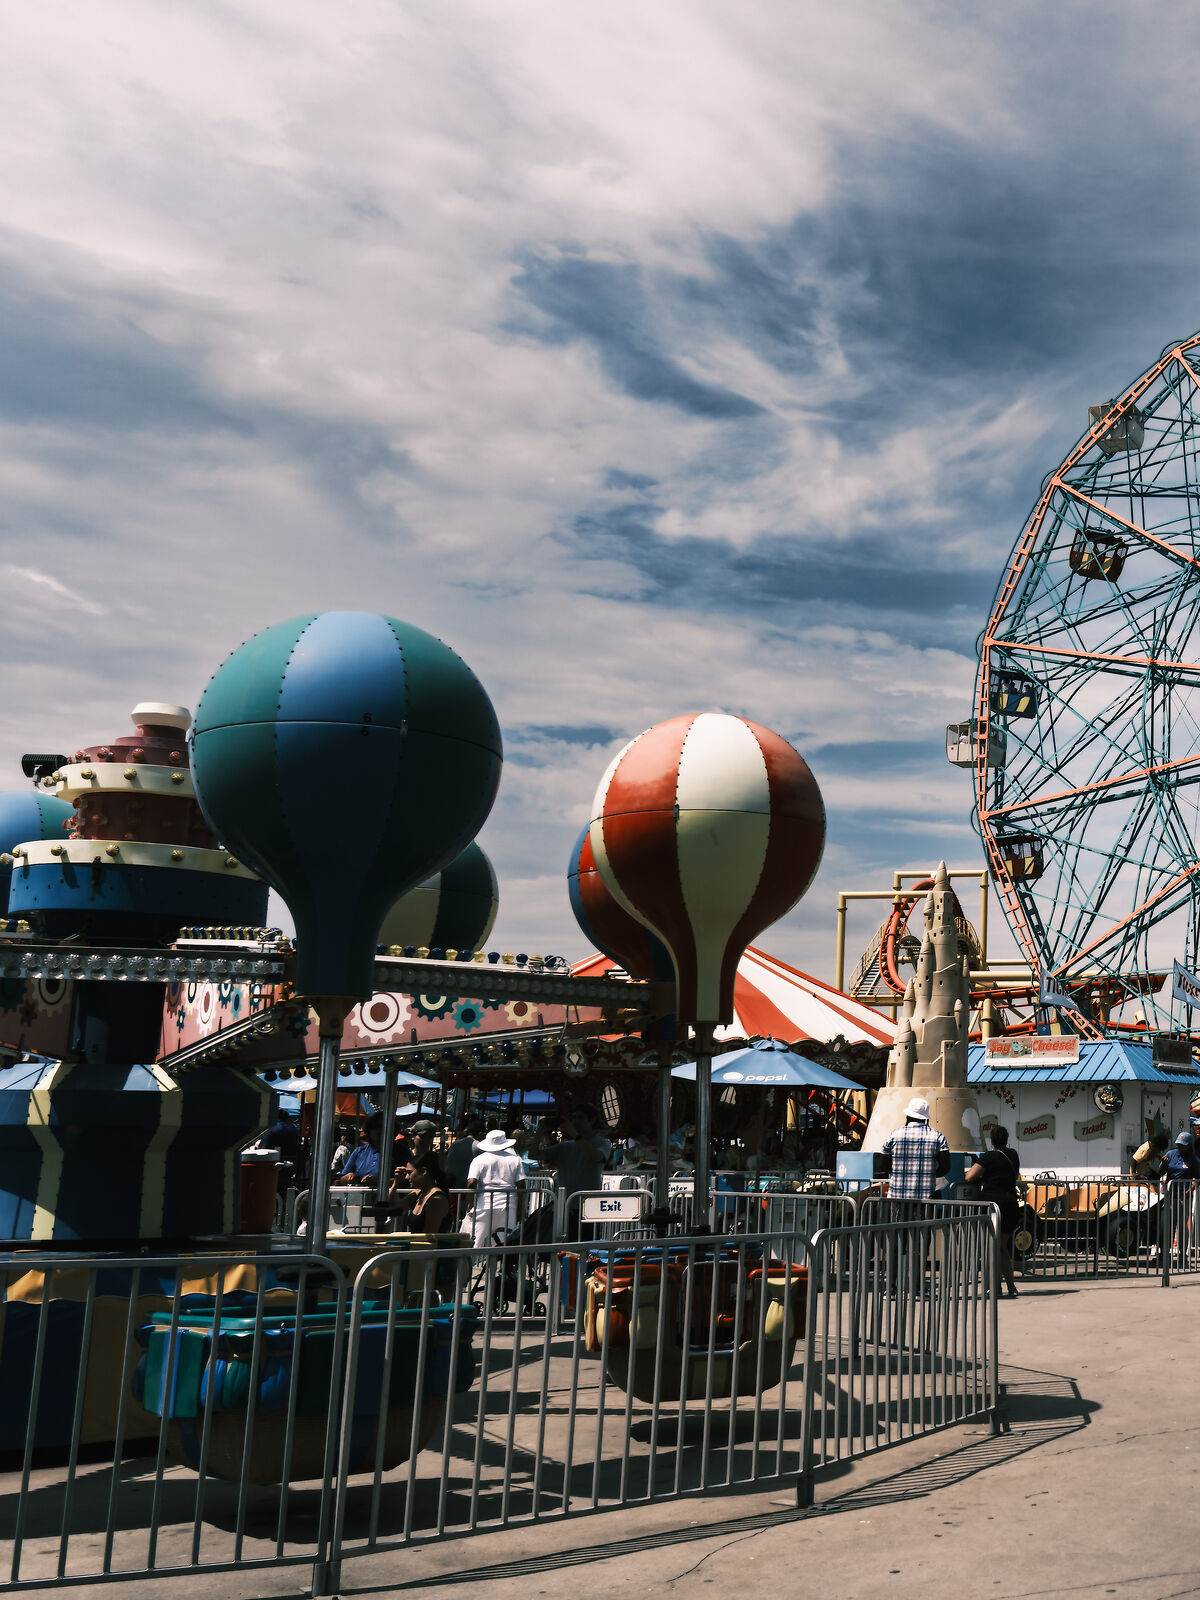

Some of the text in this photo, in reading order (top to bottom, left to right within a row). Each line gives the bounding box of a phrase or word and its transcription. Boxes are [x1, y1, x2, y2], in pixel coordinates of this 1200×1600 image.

[989, 1040, 1077, 1055] Say Cheese!
[745, 1074, 787, 1082] pepsi
[1023, 1122, 1048, 1136] Photos
[1081, 1121, 1107, 1136] Tickets
[600, 1200, 622, 1212] Exit
